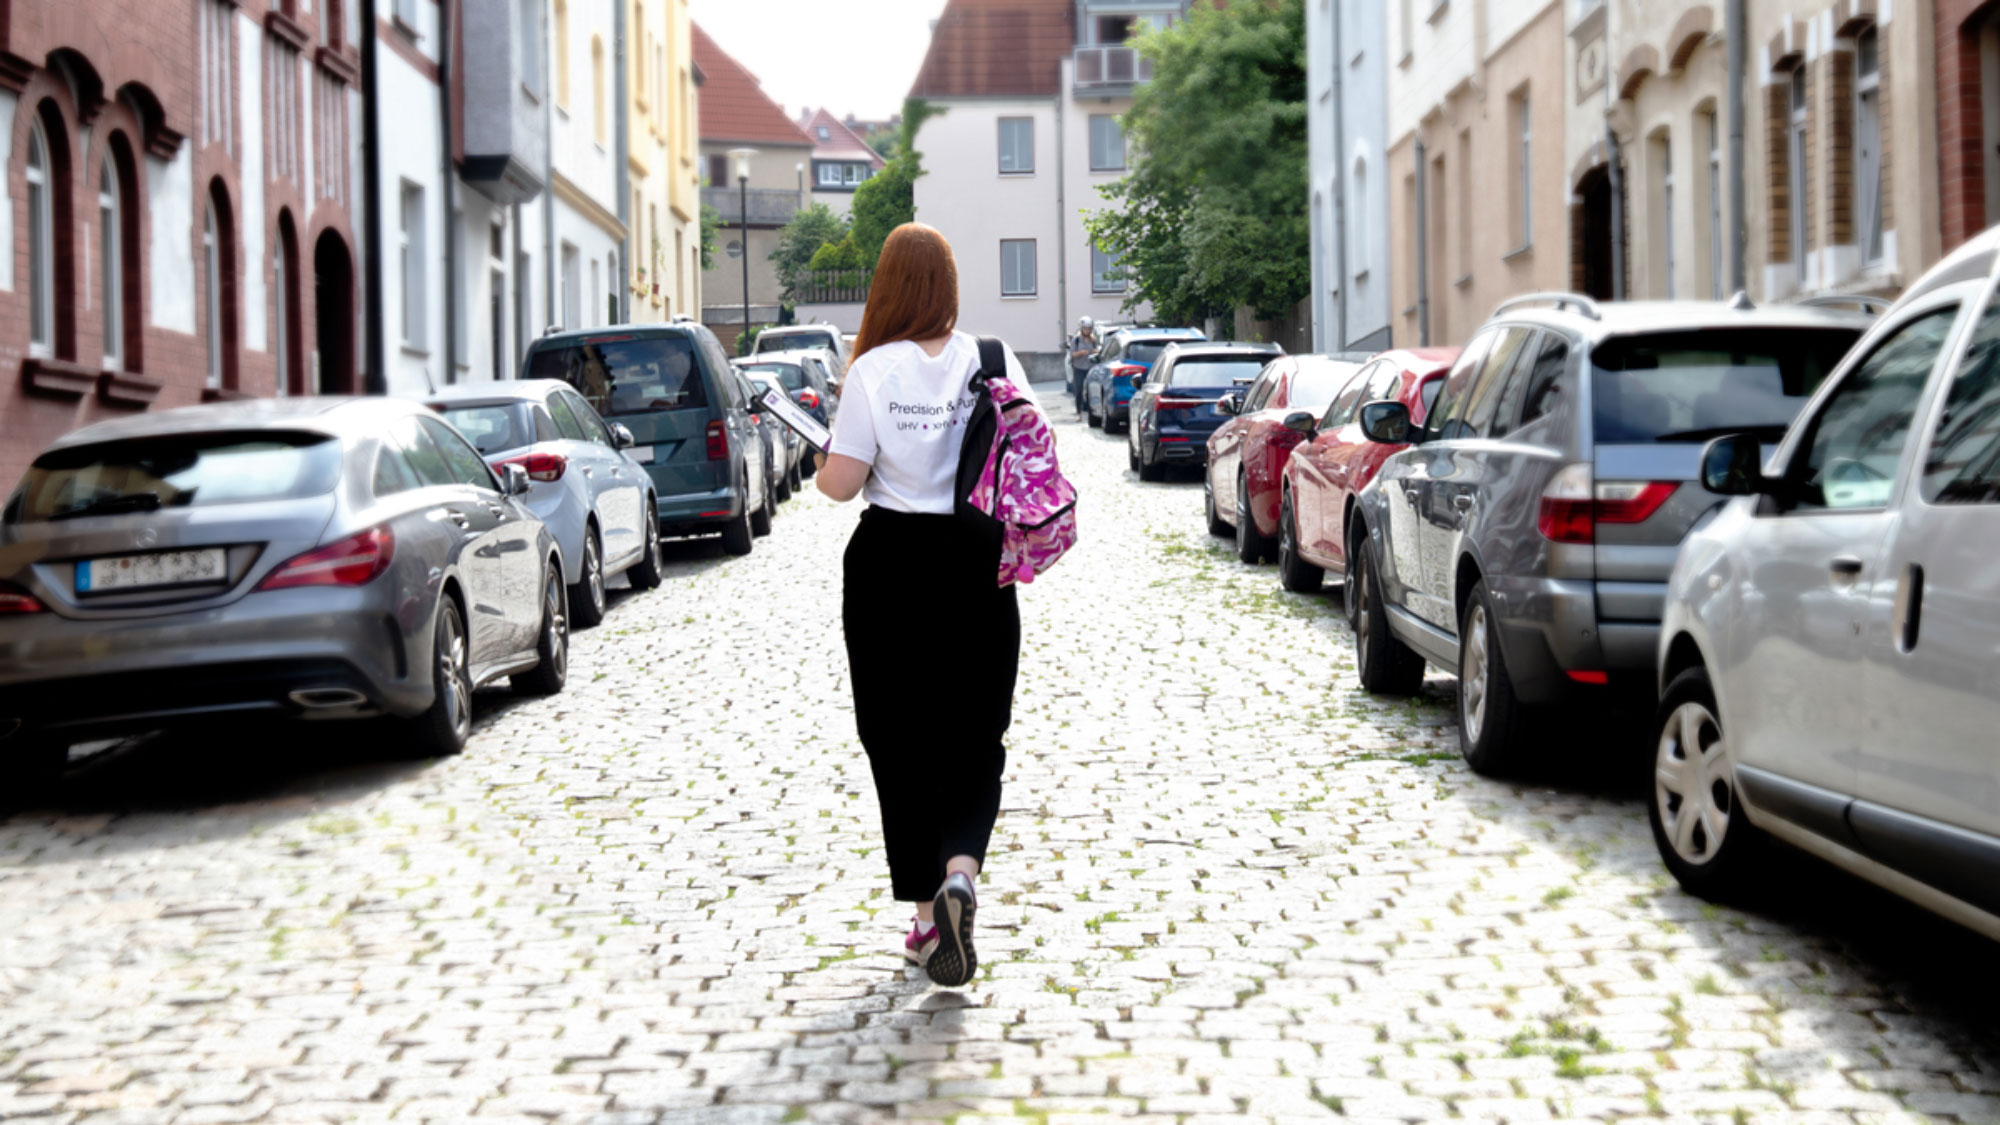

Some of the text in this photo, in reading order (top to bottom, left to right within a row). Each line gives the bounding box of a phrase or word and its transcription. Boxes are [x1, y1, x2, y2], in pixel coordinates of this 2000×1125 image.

[889, 398, 978, 416] Precision & Pur
[897, 421, 918, 431] UHV
